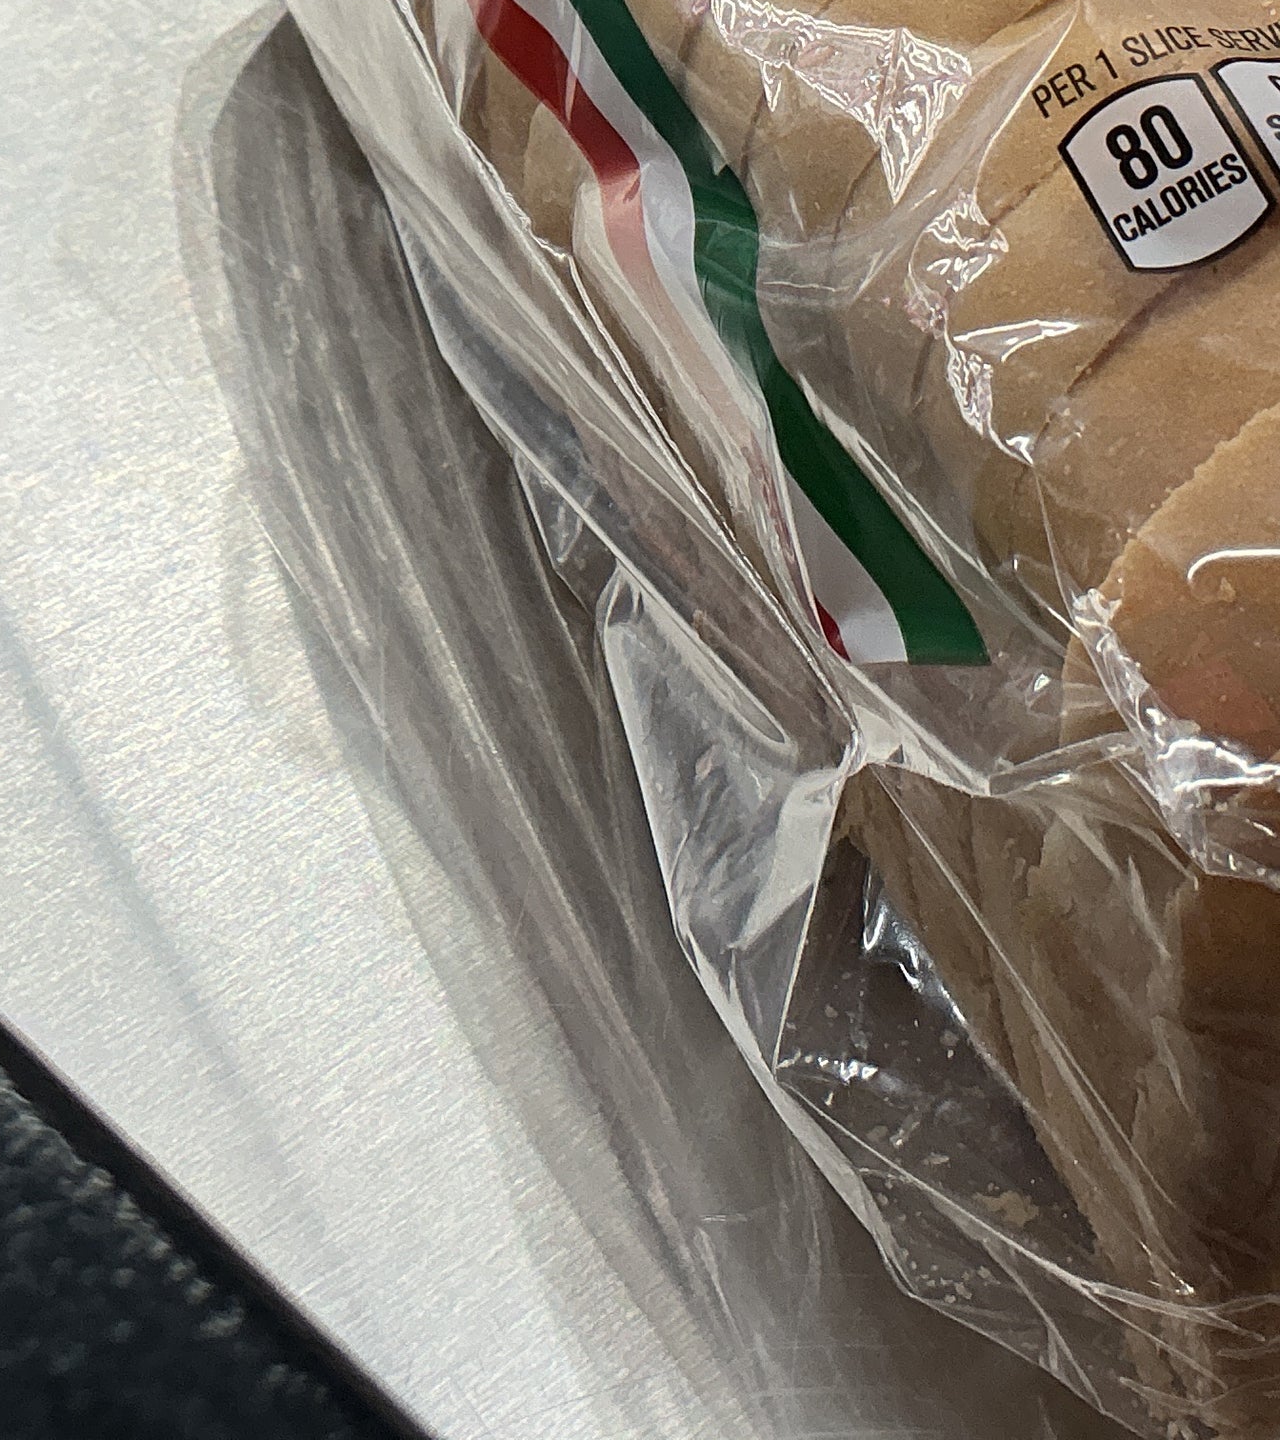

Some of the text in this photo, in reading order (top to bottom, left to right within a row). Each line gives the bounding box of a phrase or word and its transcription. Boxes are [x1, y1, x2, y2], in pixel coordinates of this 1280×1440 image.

[1032, 64, 1096, 118] PER
[1095, 49, 1118, 79] 1
[1122, 26, 1210, 67] SLICE
[1105, 105, 1193, 190] 80
[1112, 154, 1248, 242] CALORIES
